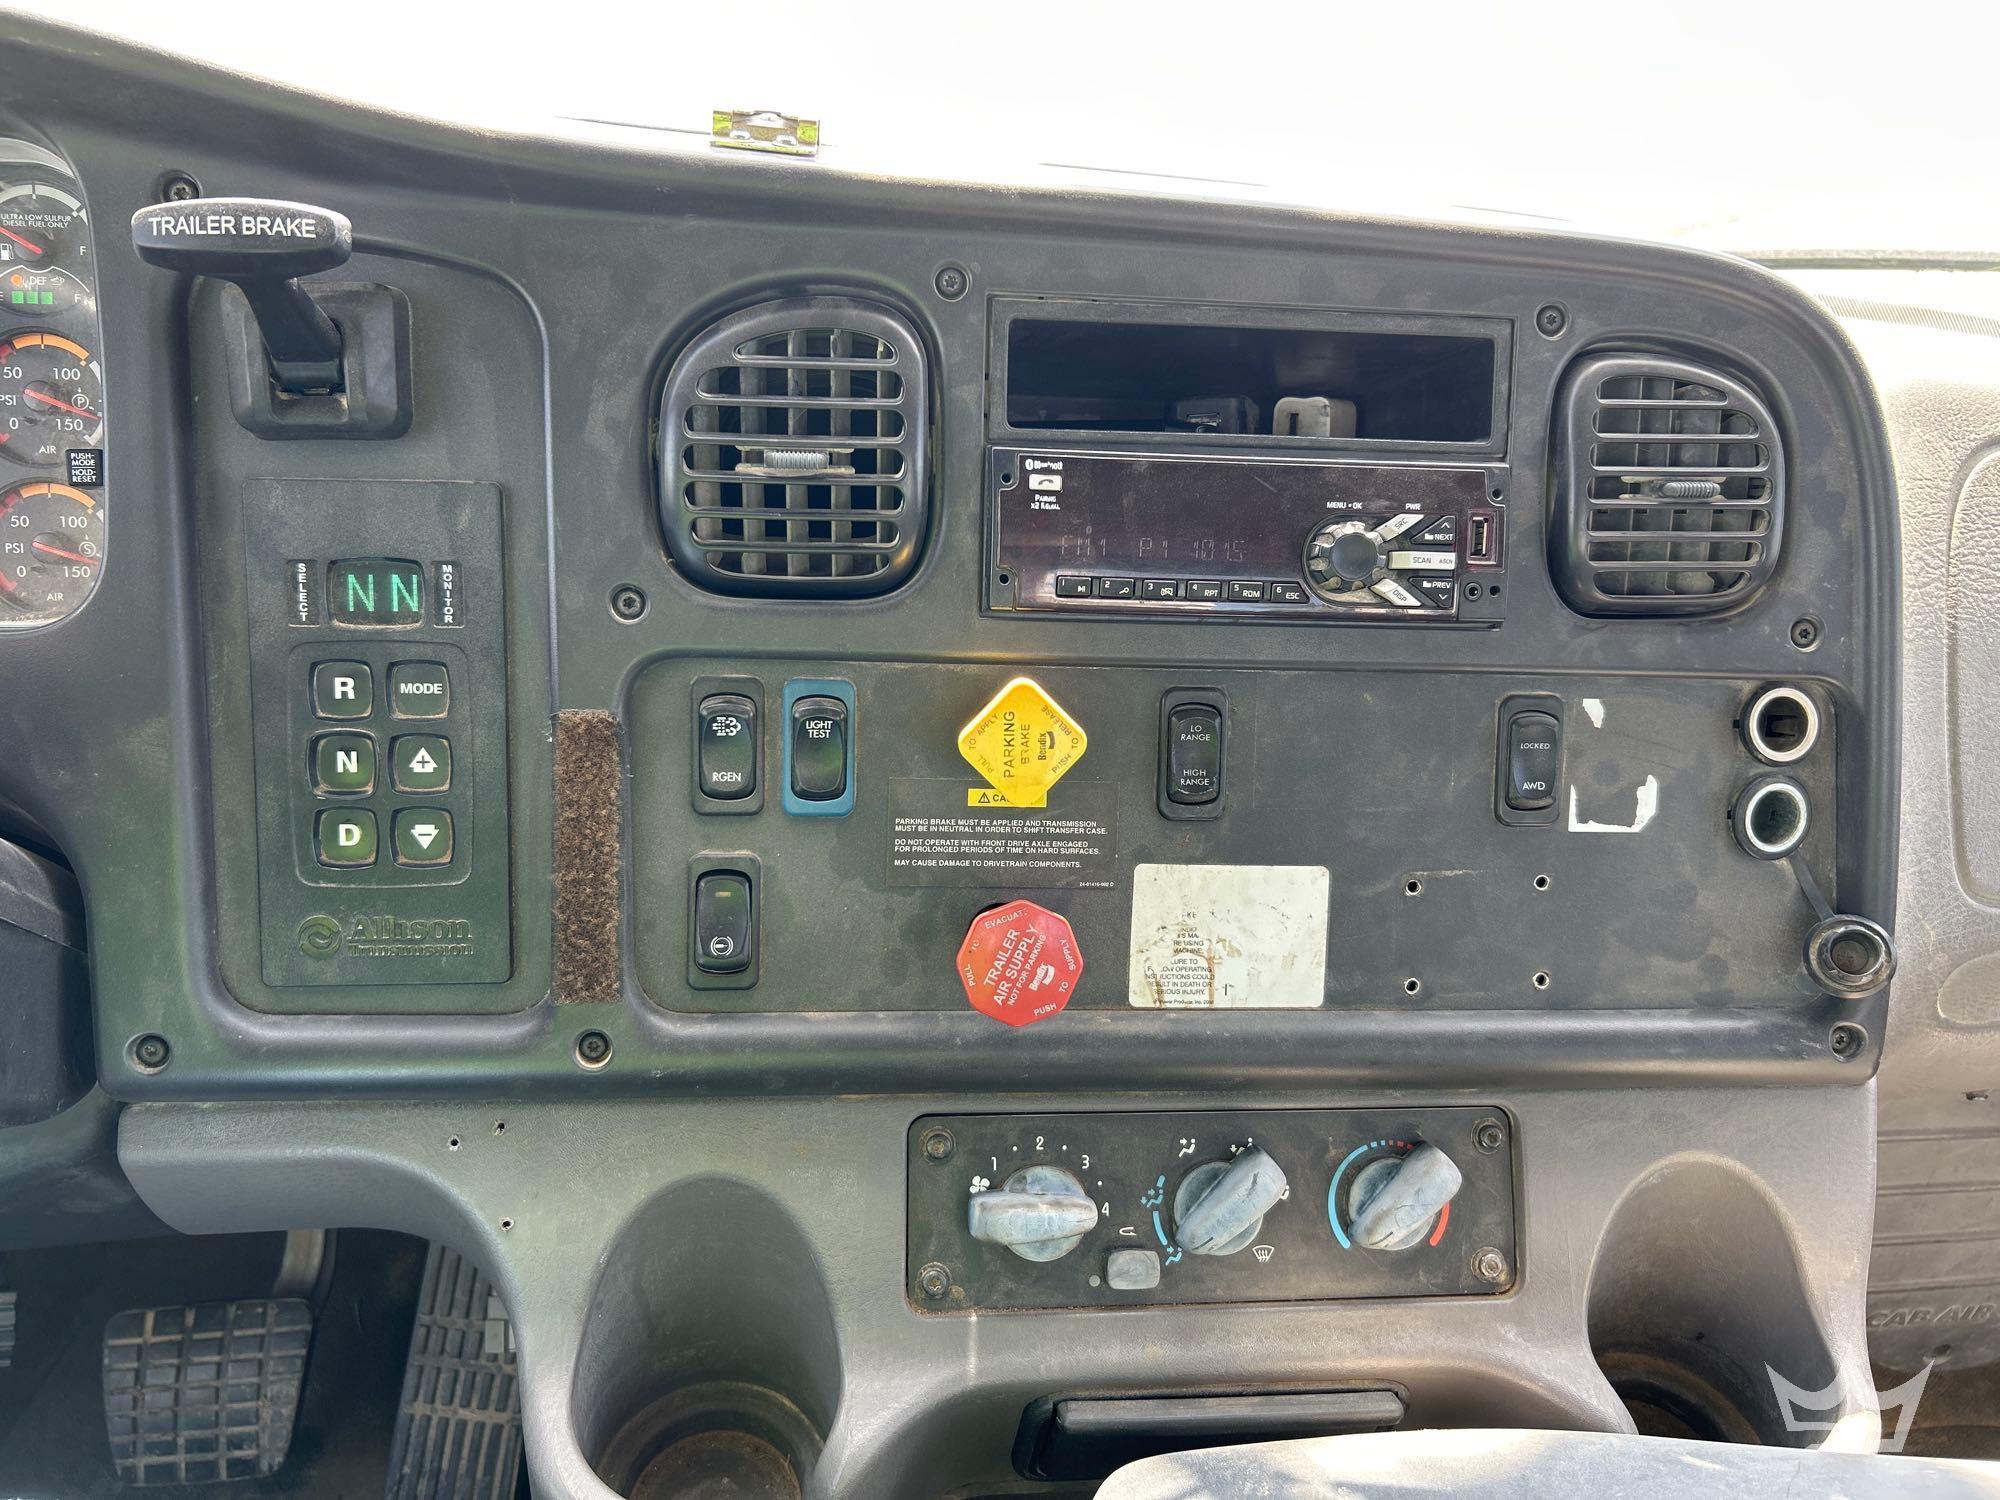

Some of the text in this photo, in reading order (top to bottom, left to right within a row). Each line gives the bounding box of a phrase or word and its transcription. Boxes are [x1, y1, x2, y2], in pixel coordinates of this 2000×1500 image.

[44, 214, 72, 222] SULFUR
[28, 220, 46, 228] FUEL
[47, 221, 69, 229] ONLY
[149, 216, 317, 238] TRAILER BRAKE
[80, 246, 87, 255] F
[30, 276, 47, 285] DEF
[3, 366, 22, 379] 50
[53, 368, 80, 380] 100
[9, 417, 19, 430] 0
[56, 419, 83, 431] 150
[39, 445, 56, 454] AIR
[1326, 501, 1363, 510] MENU OK
[10, 516, 29, 527] 50
[60, 516, 87, 528] 100
[5, 543, 24, 553] PSI
[1412, 556, 1432, 564] SCAN
[16, 566, 26, 577] 0
[63, 566, 90, 578] 150
[1432, 581, 1451, 589] PREV
[47, 592, 64, 601] AIR
[298, 563, 308, 622] SELECT
[348, 574, 419, 612] N N
[442, 564, 453, 624] MONITOR
[1285, 592, 1300, 600] ESC
[334, 677, 355, 699] R
[400, 683, 443, 695] MODE
[806, 720, 833, 731] LIGHT
[1190, 725, 1202, 733] LO
[808, 730, 831, 738] TEST
[1180, 733, 1211, 741] RANGE
[1004, 711, 1015, 778] PARKING
[1021, 723, 1031, 765] BRAKE
[1038, 732, 1047, 761] Bendix
[1520, 742, 1550, 750] LOCKED
[336, 751, 358, 773] N
[712, 771, 741, 782] RGEN
[1183, 769, 1206, 777] HIGH
[1180, 778, 1210, 786] RANGE
[1522, 781, 1546, 791] AWD
[930, 818, 956, 826] BRAKE
[339, 824, 362, 847] D
[347, 916, 472, 939] Allison
[983, 928, 1020, 986] TRAILER
[993, 923, 1040, 1006] AIR SUPPLY
[1006, 934, 1047, 1006] NOT FOR PARKING
[1033, 939, 1076, 1016] PUSH TO SUPPLY
[1035, 1135, 1044, 1150] 2
[991, 1156, 997, 1171] 1
[1081, 1154, 1090, 1169] 3
[1101, 1202, 1110, 1217] 4
